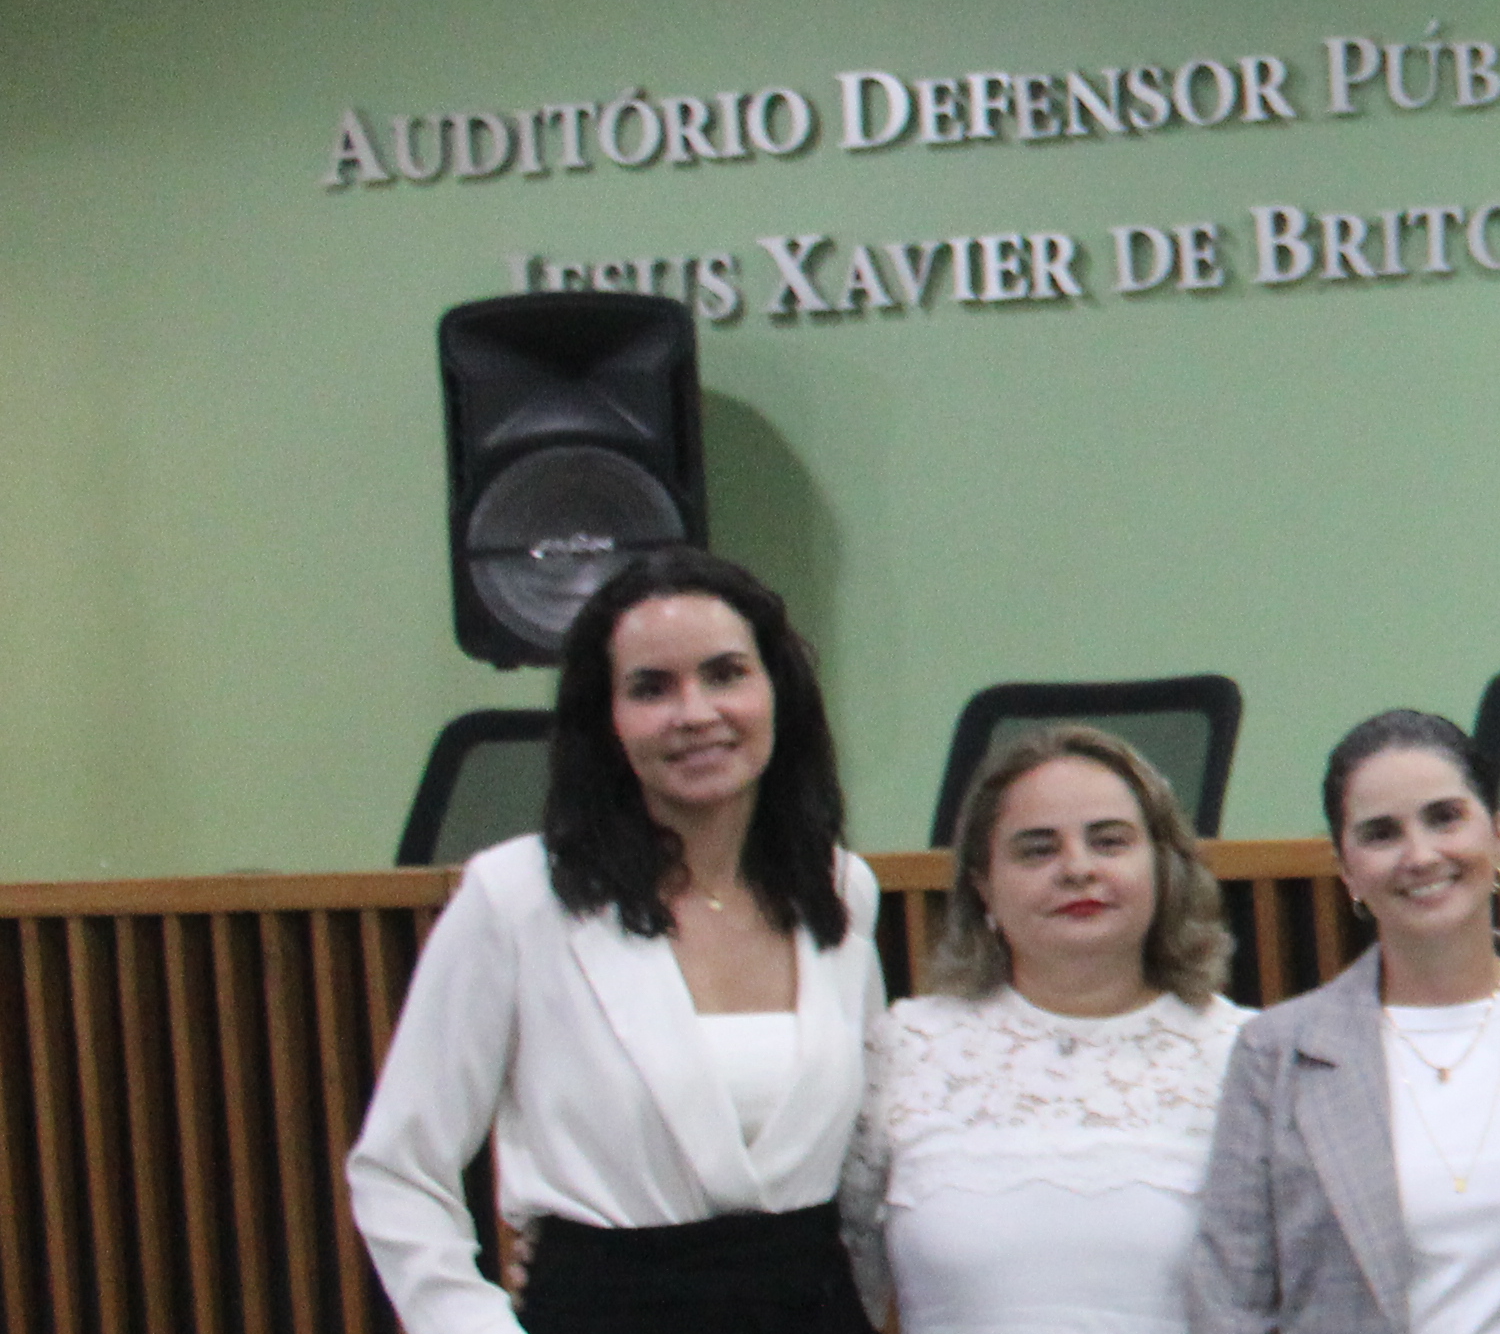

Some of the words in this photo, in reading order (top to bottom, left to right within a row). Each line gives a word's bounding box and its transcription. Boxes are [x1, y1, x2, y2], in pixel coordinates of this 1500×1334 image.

[323, 84, 813, 187] AUDITÓRIO
[836, 54, 1297, 150] DEFENSOR
[756, 231, 1083, 313] XAVIER
[1111, 222, 1226, 294] DE
